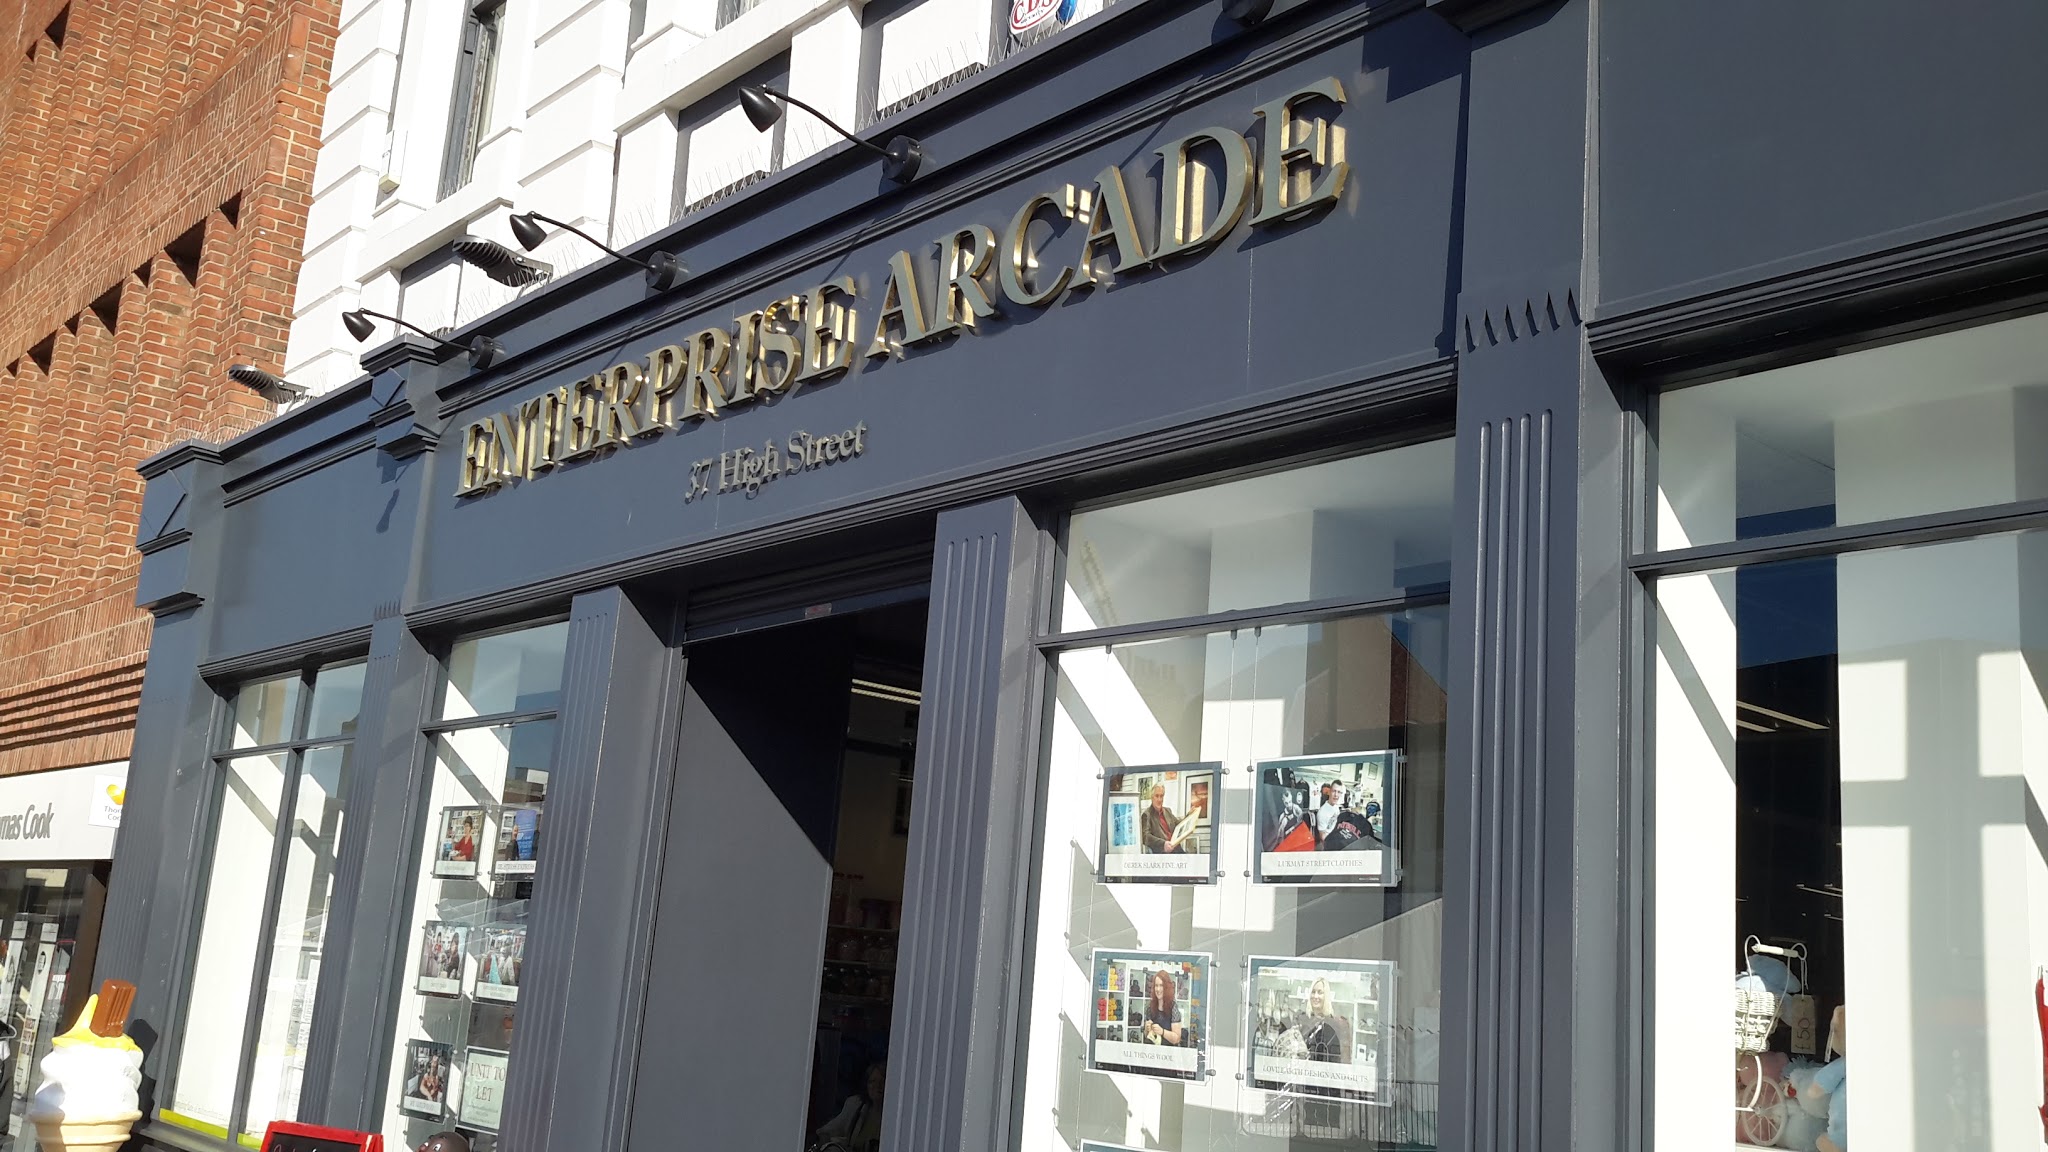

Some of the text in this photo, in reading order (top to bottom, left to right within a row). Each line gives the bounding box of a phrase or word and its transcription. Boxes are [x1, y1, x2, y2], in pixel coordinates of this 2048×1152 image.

[452, 76, 1352, 498] ENTERPRISE ARCADE
[684, 420, 866, 499] 37 High Street
[23, 802, 54, 839] Cook
[1133, 1051, 1156, 1060] THINGS
[493, 1066, 506, 1082] TO
[1304, 1069, 1330, 1078] DESIGN
[475, 1085, 493, 1102] LET
